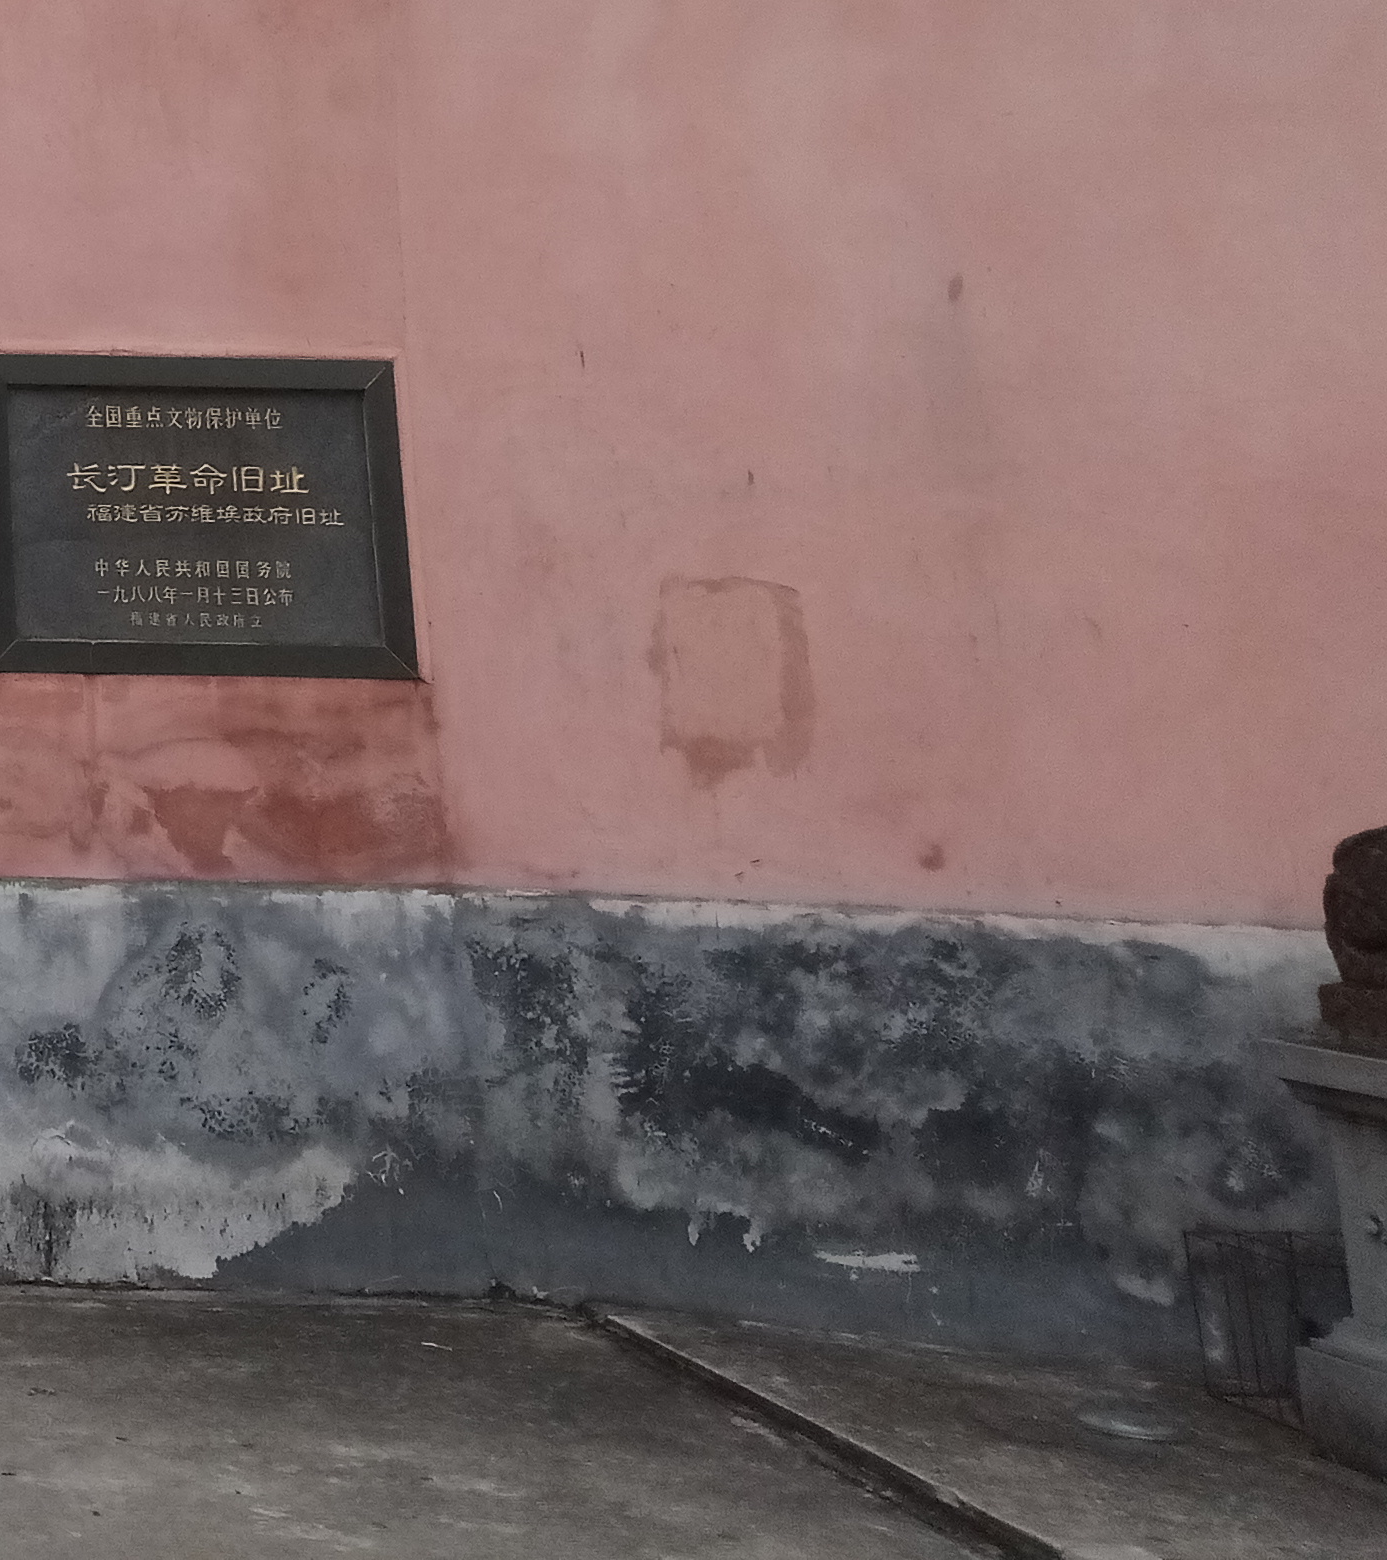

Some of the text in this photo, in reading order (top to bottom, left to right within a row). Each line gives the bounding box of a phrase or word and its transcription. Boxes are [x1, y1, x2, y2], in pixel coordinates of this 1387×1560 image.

[85, 405, 283, 431] 全国重点文物保护单位
[66, 462, 311, 496] 长汀革命旧址
[86, 503, 345, 527] 福建省苏维埃政府旧址
[95, 559, 292, 580] 中华人民共和国国务院
[97, 585, 295, 607] 一九八八年一月十三日公布
[130, 611, 263, 628] 福建省人民政府立
